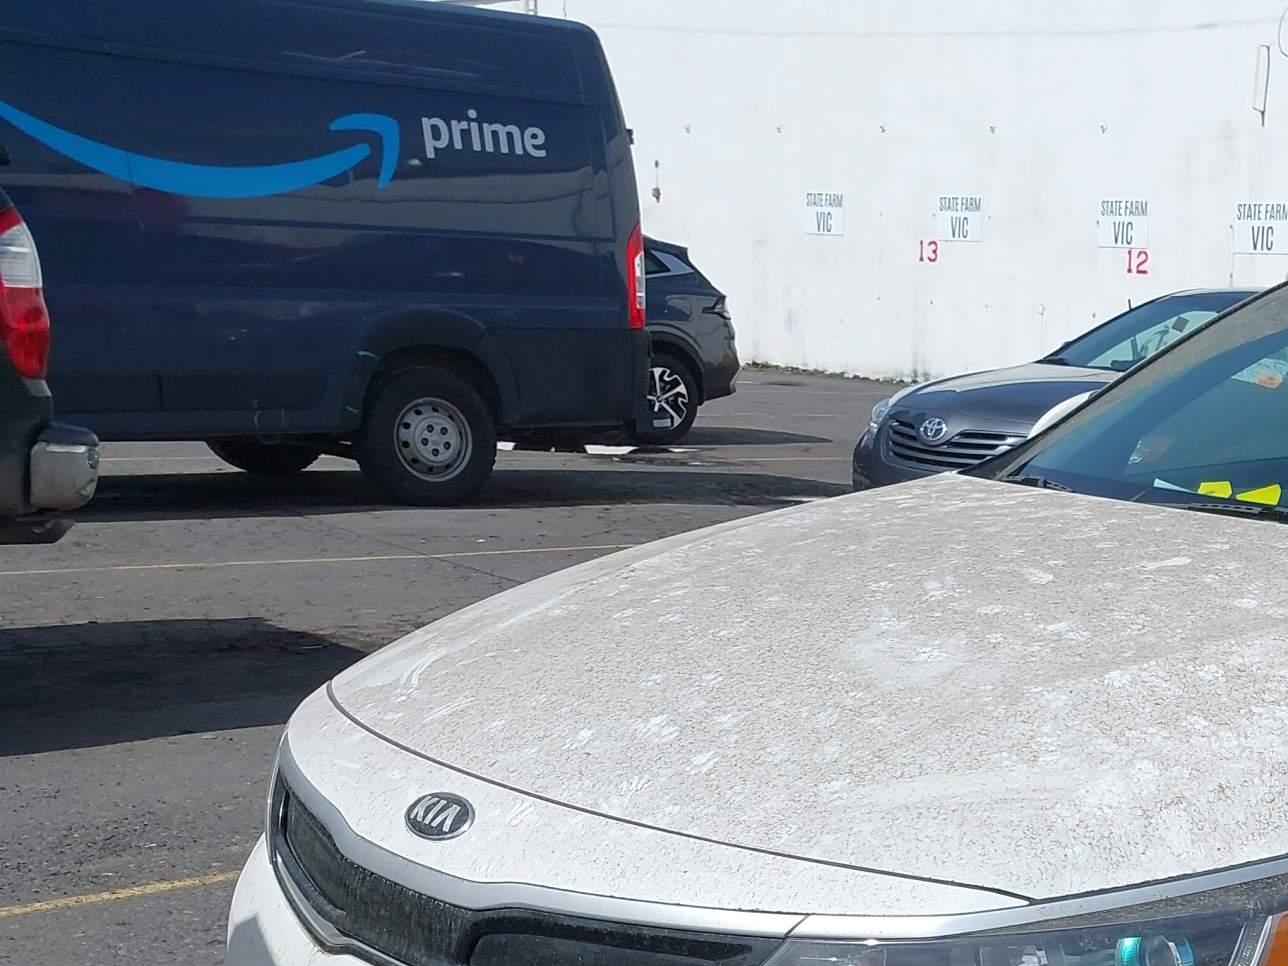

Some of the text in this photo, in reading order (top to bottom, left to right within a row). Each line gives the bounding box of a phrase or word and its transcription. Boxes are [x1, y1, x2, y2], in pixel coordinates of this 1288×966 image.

[421, 109, 547, 159] prime
[806, 192, 843, 208] STATE FARM
[939, 197, 982, 213] STATE FARM
[1100, 200, 1148, 217] STATE FARM
[816, 211, 832, 233] VIC
[1237, 203, 1263, 221] STATE
[950, 216, 969, 239] VIC
[1113, 221, 1134, 246] VIC
[1251, 225, 1275, 251] VIC
[918, 239, 939, 263] 13
[1127, 249, 1149, 275] 12
[409, 795, 462, 833] KIA
